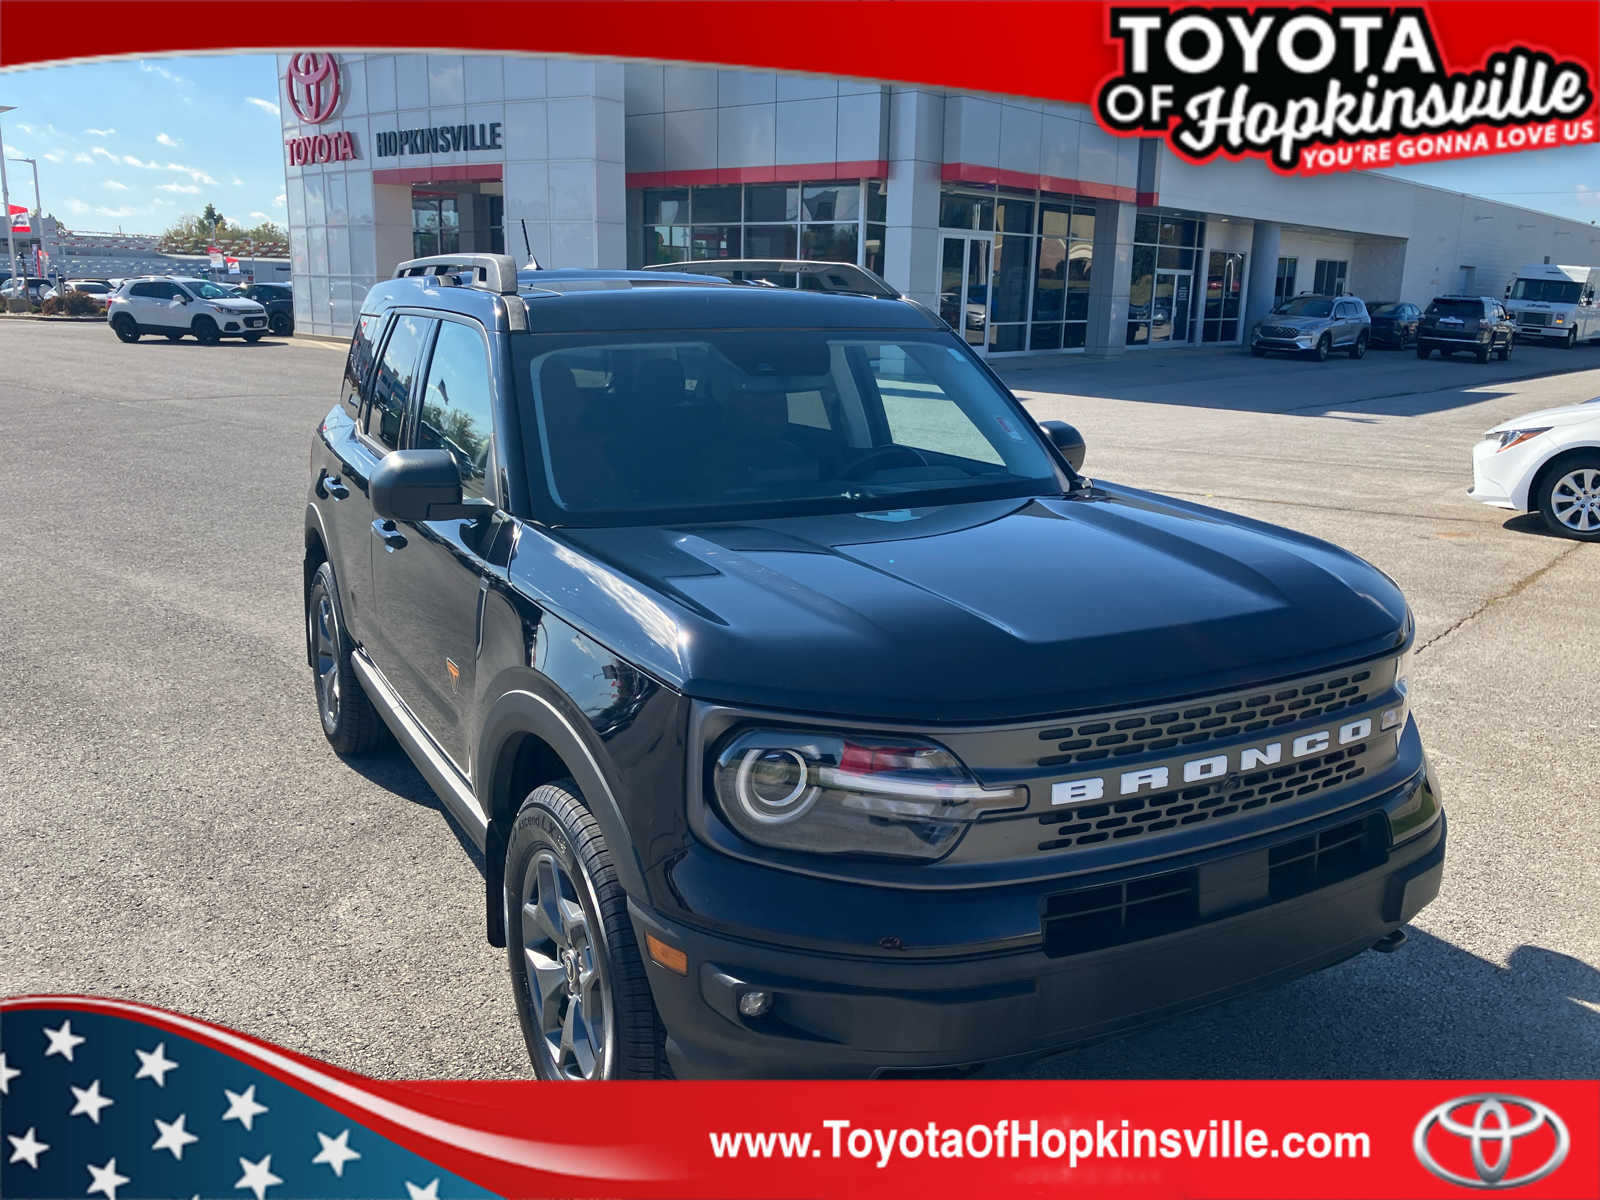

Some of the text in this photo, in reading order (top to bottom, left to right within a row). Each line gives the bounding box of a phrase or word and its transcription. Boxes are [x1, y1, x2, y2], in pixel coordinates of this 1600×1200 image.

[285, 131, 357, 167] TOYOTA
[376, 122, 503, 158] HOPKINSVILLE
[1051, 718, 1373, 806] BRONCO
